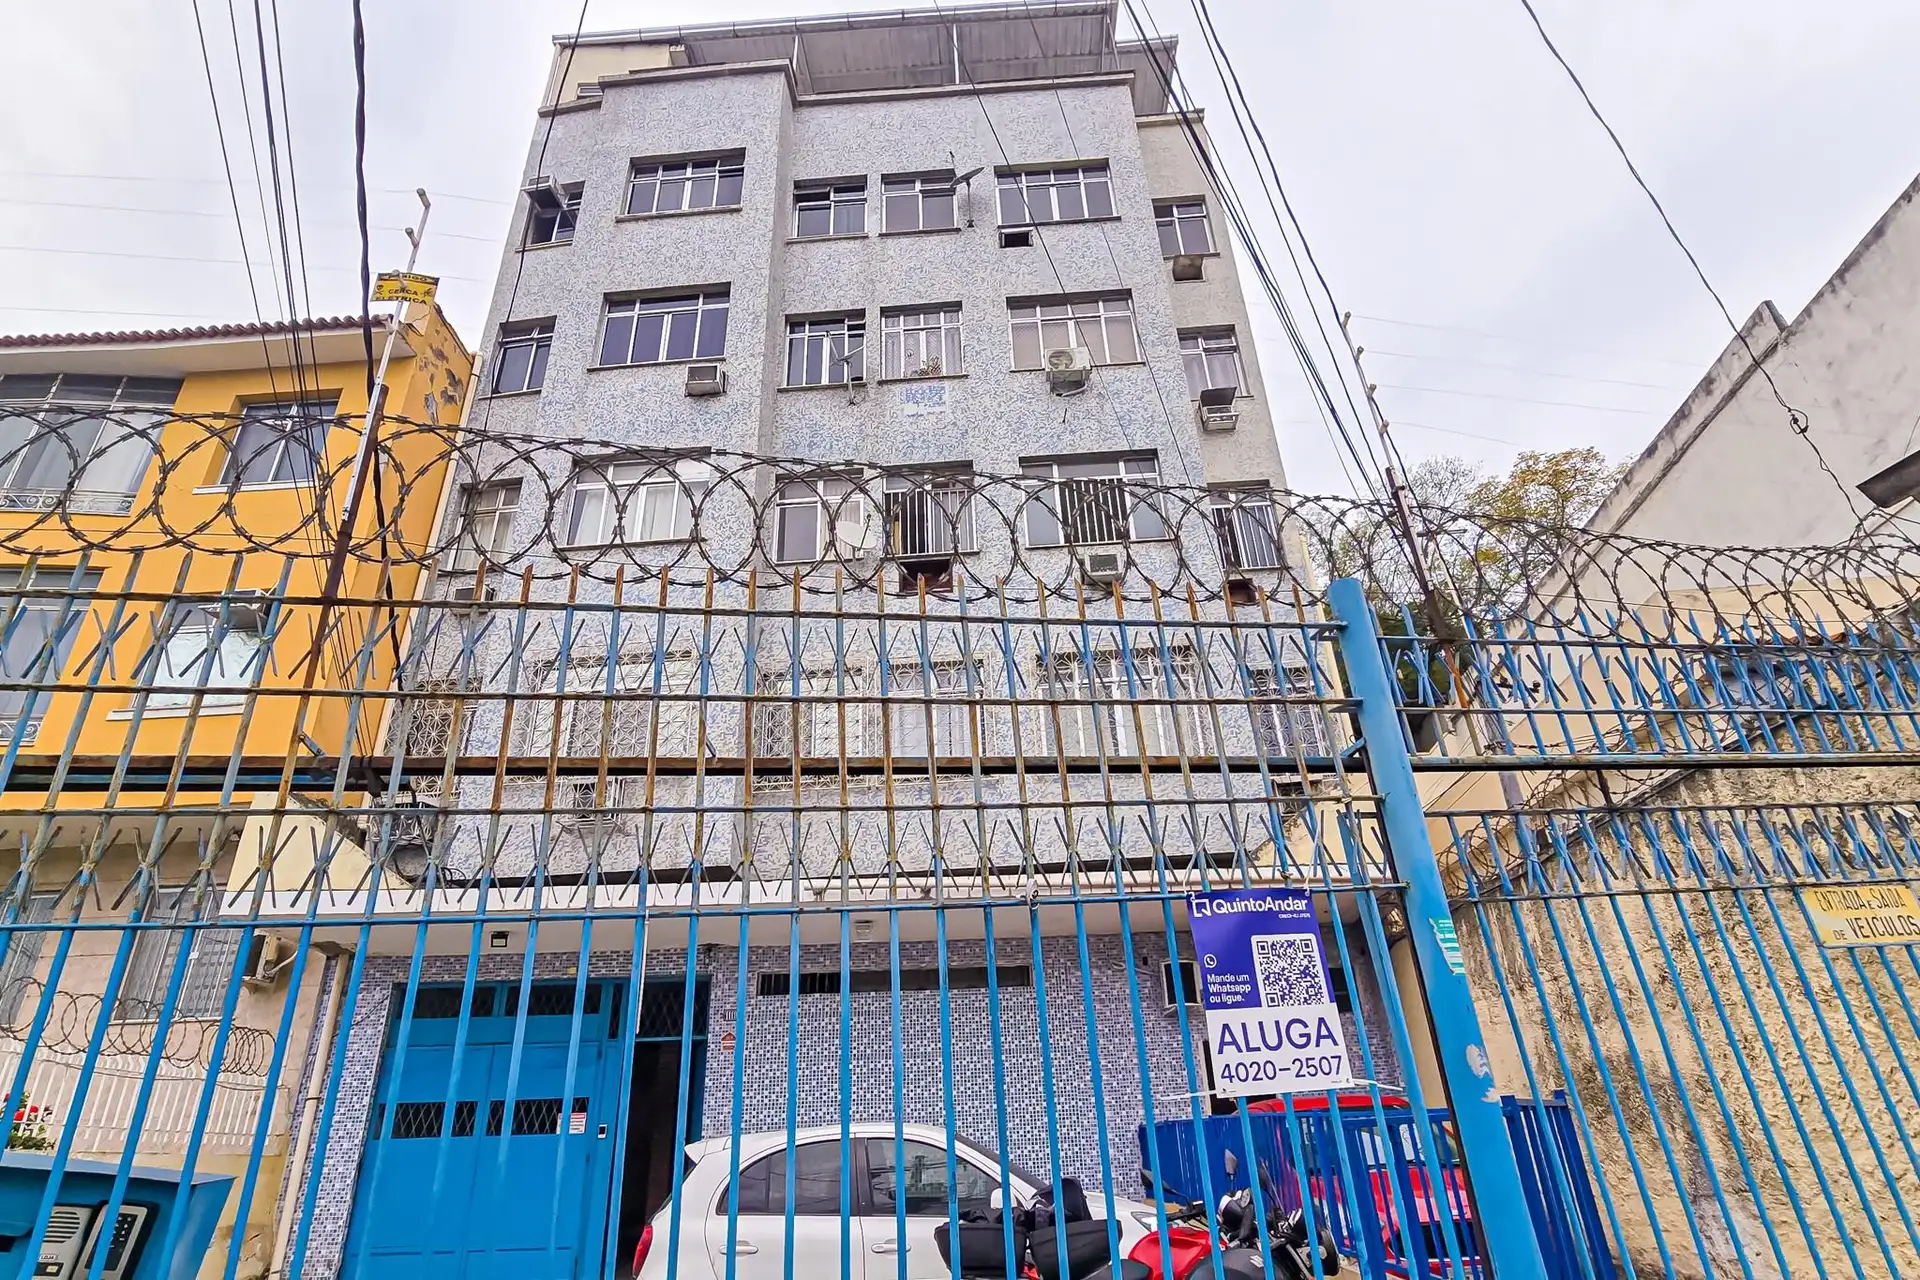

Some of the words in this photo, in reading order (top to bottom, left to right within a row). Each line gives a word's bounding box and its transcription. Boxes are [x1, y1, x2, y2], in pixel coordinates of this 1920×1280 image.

[1213, 896, 1308, 914] QuintoAndar
[1814, 889, 1867, 912] ENTRADA
[1832, 929, 1847, 941] DE
[1207, 973, 1235, 983] Mande
[1208, 983, 1251, 994] Whatsapp
[1209, 995, 1221, 1003] ou
[1217, 1016, 1339, 1055] ALUGA
[1220, 1055, 1342, 1084] 4020-2507
